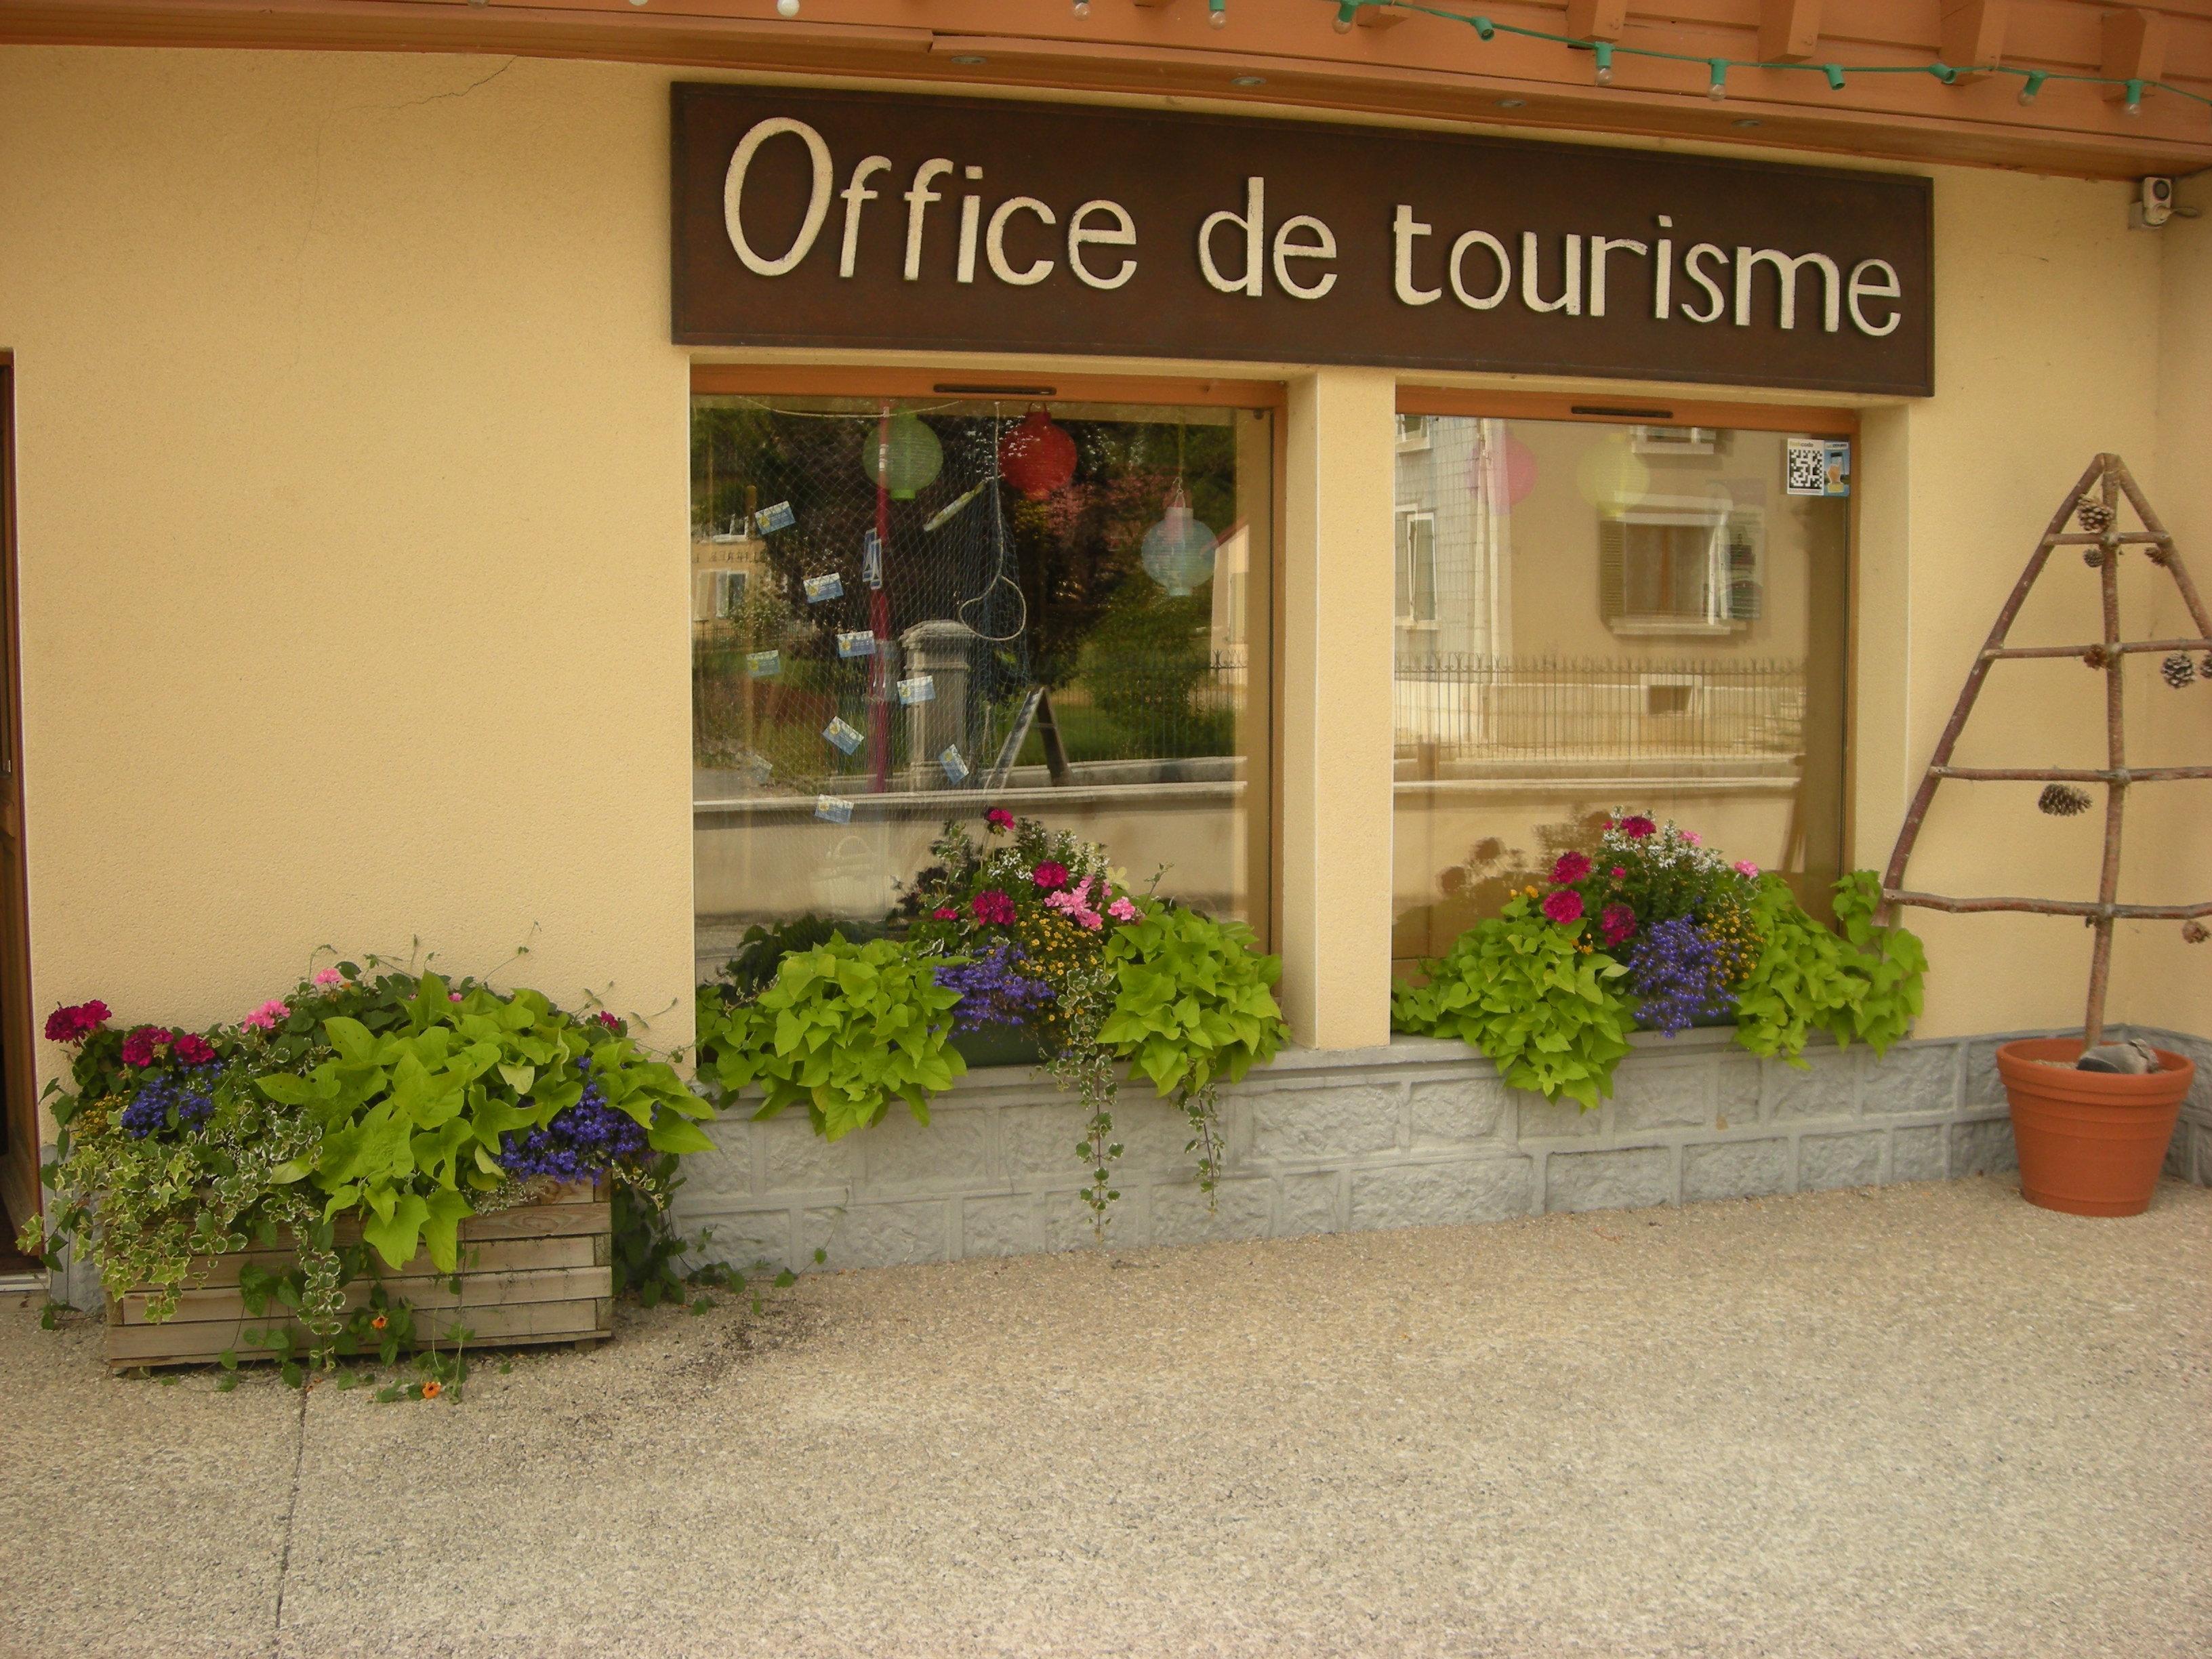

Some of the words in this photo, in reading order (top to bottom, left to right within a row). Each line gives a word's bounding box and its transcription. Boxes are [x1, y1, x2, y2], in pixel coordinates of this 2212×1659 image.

[724, 117, 1138, 290] Office
[1198, 176, 1338, 300] de
[1393, 204, 1902, 337] tourisme
